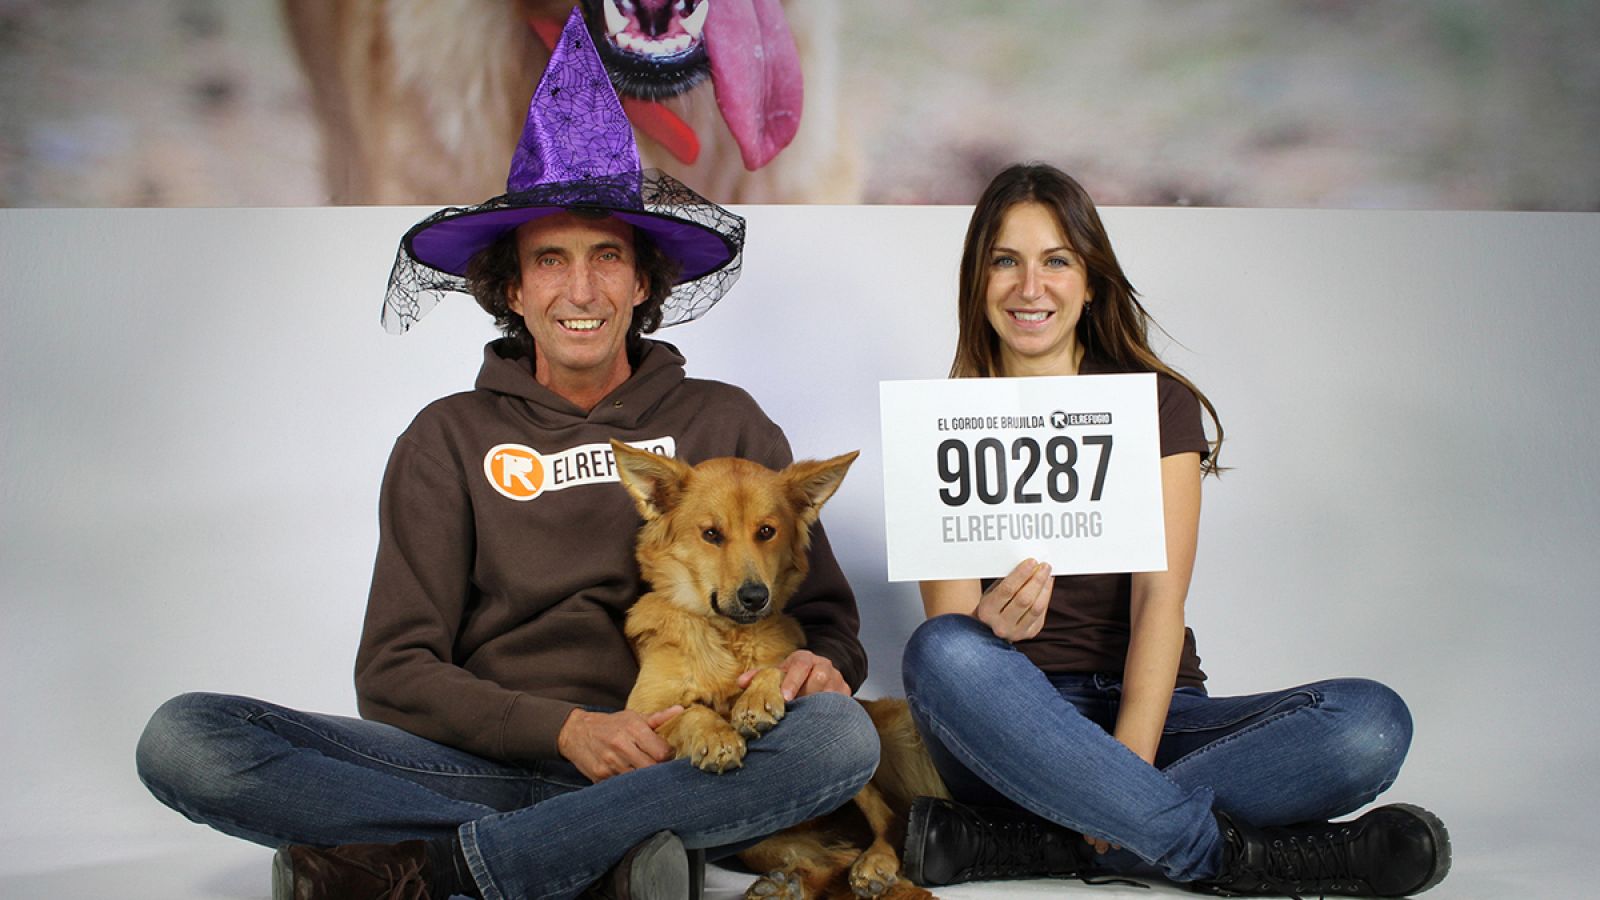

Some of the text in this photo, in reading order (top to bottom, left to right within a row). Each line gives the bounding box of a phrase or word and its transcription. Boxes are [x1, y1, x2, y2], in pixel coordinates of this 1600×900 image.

[938, 418, 950, 431] EL
[952, 417, 985, 431] GORDO
[986, 416, 999, 430] DE
[1001, 415, 1045, 429] BRUJILDA
[1071, 414, 1110, 425] ELREFUGIO
[937, 435, 1113, 507] 90287
[942, 511, 1103, 543] ELREFUGIO.ORG
